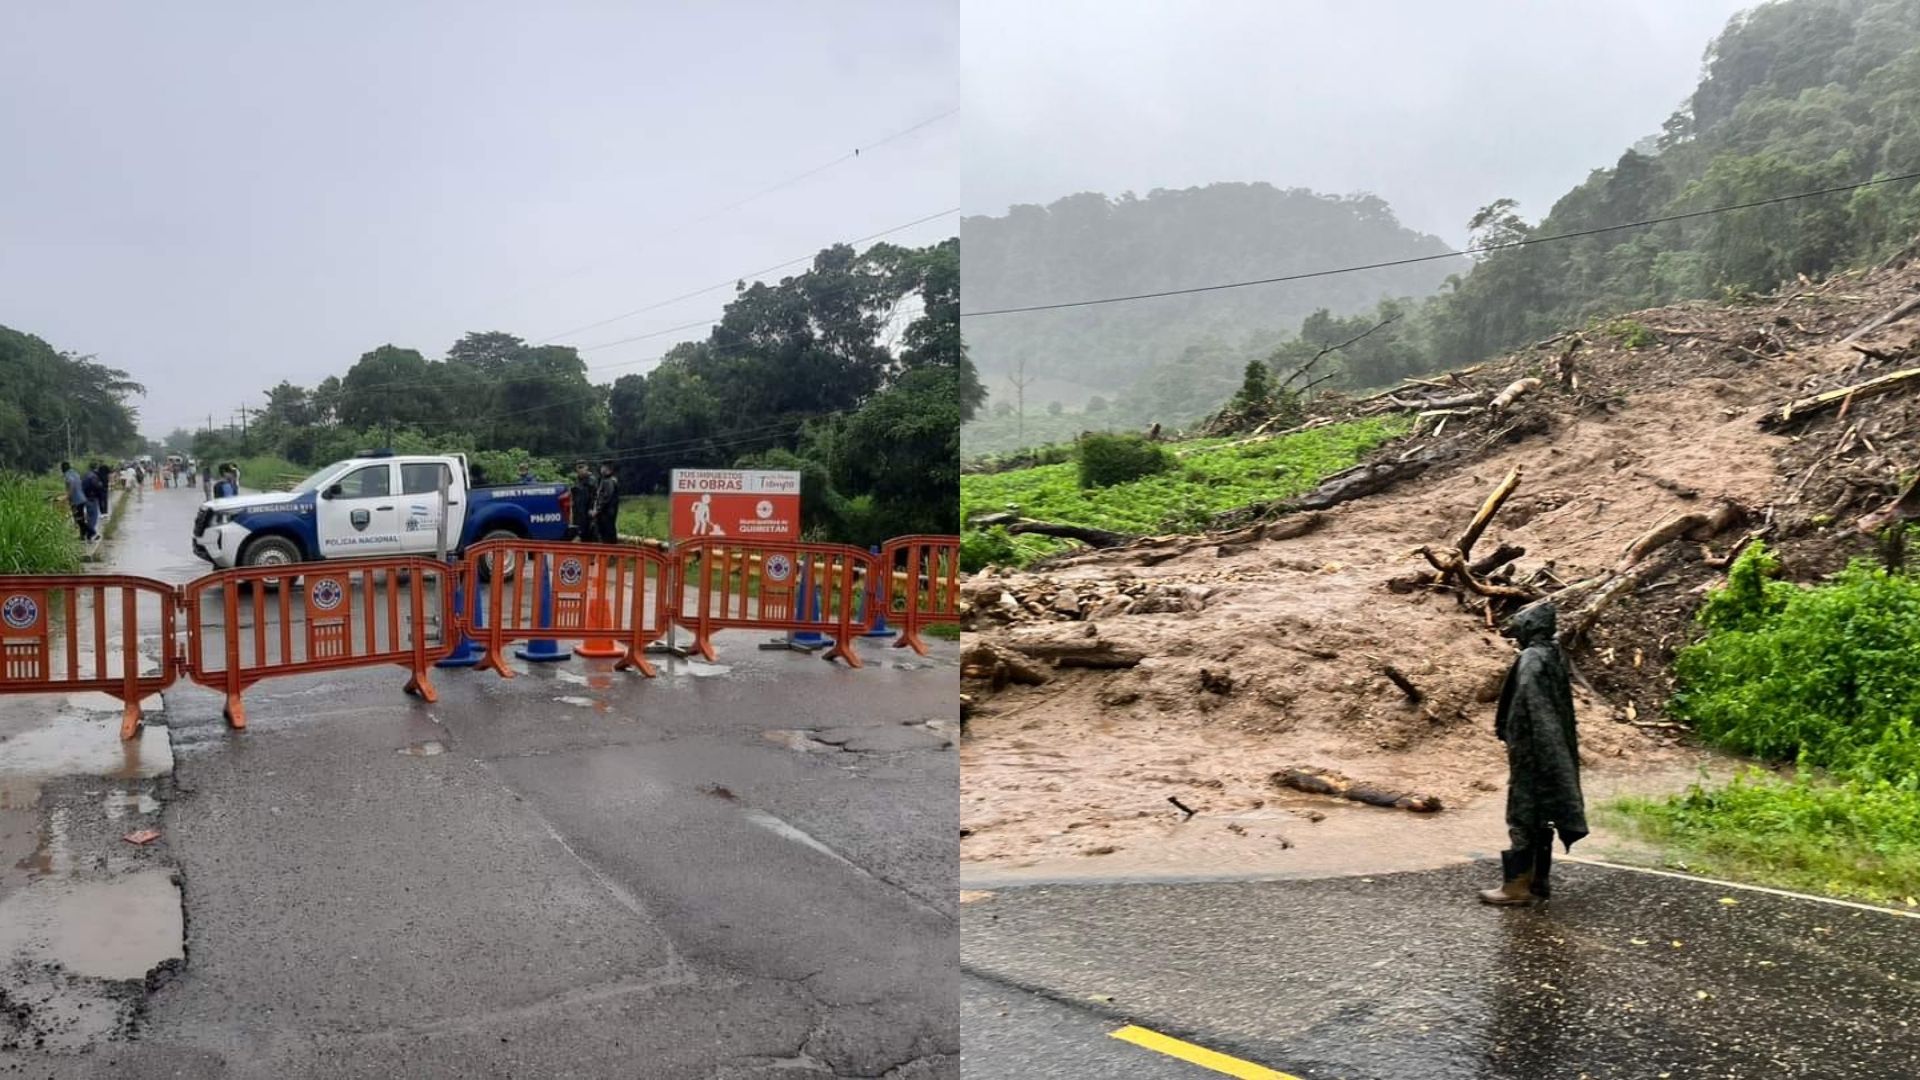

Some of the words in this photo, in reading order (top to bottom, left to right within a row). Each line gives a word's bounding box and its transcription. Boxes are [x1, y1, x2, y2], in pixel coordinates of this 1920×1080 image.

[678, 479, 696, 490] EN
[699, 479, 743, 490] OBRAS
[358, 535, 398, 545] NACIONAL
